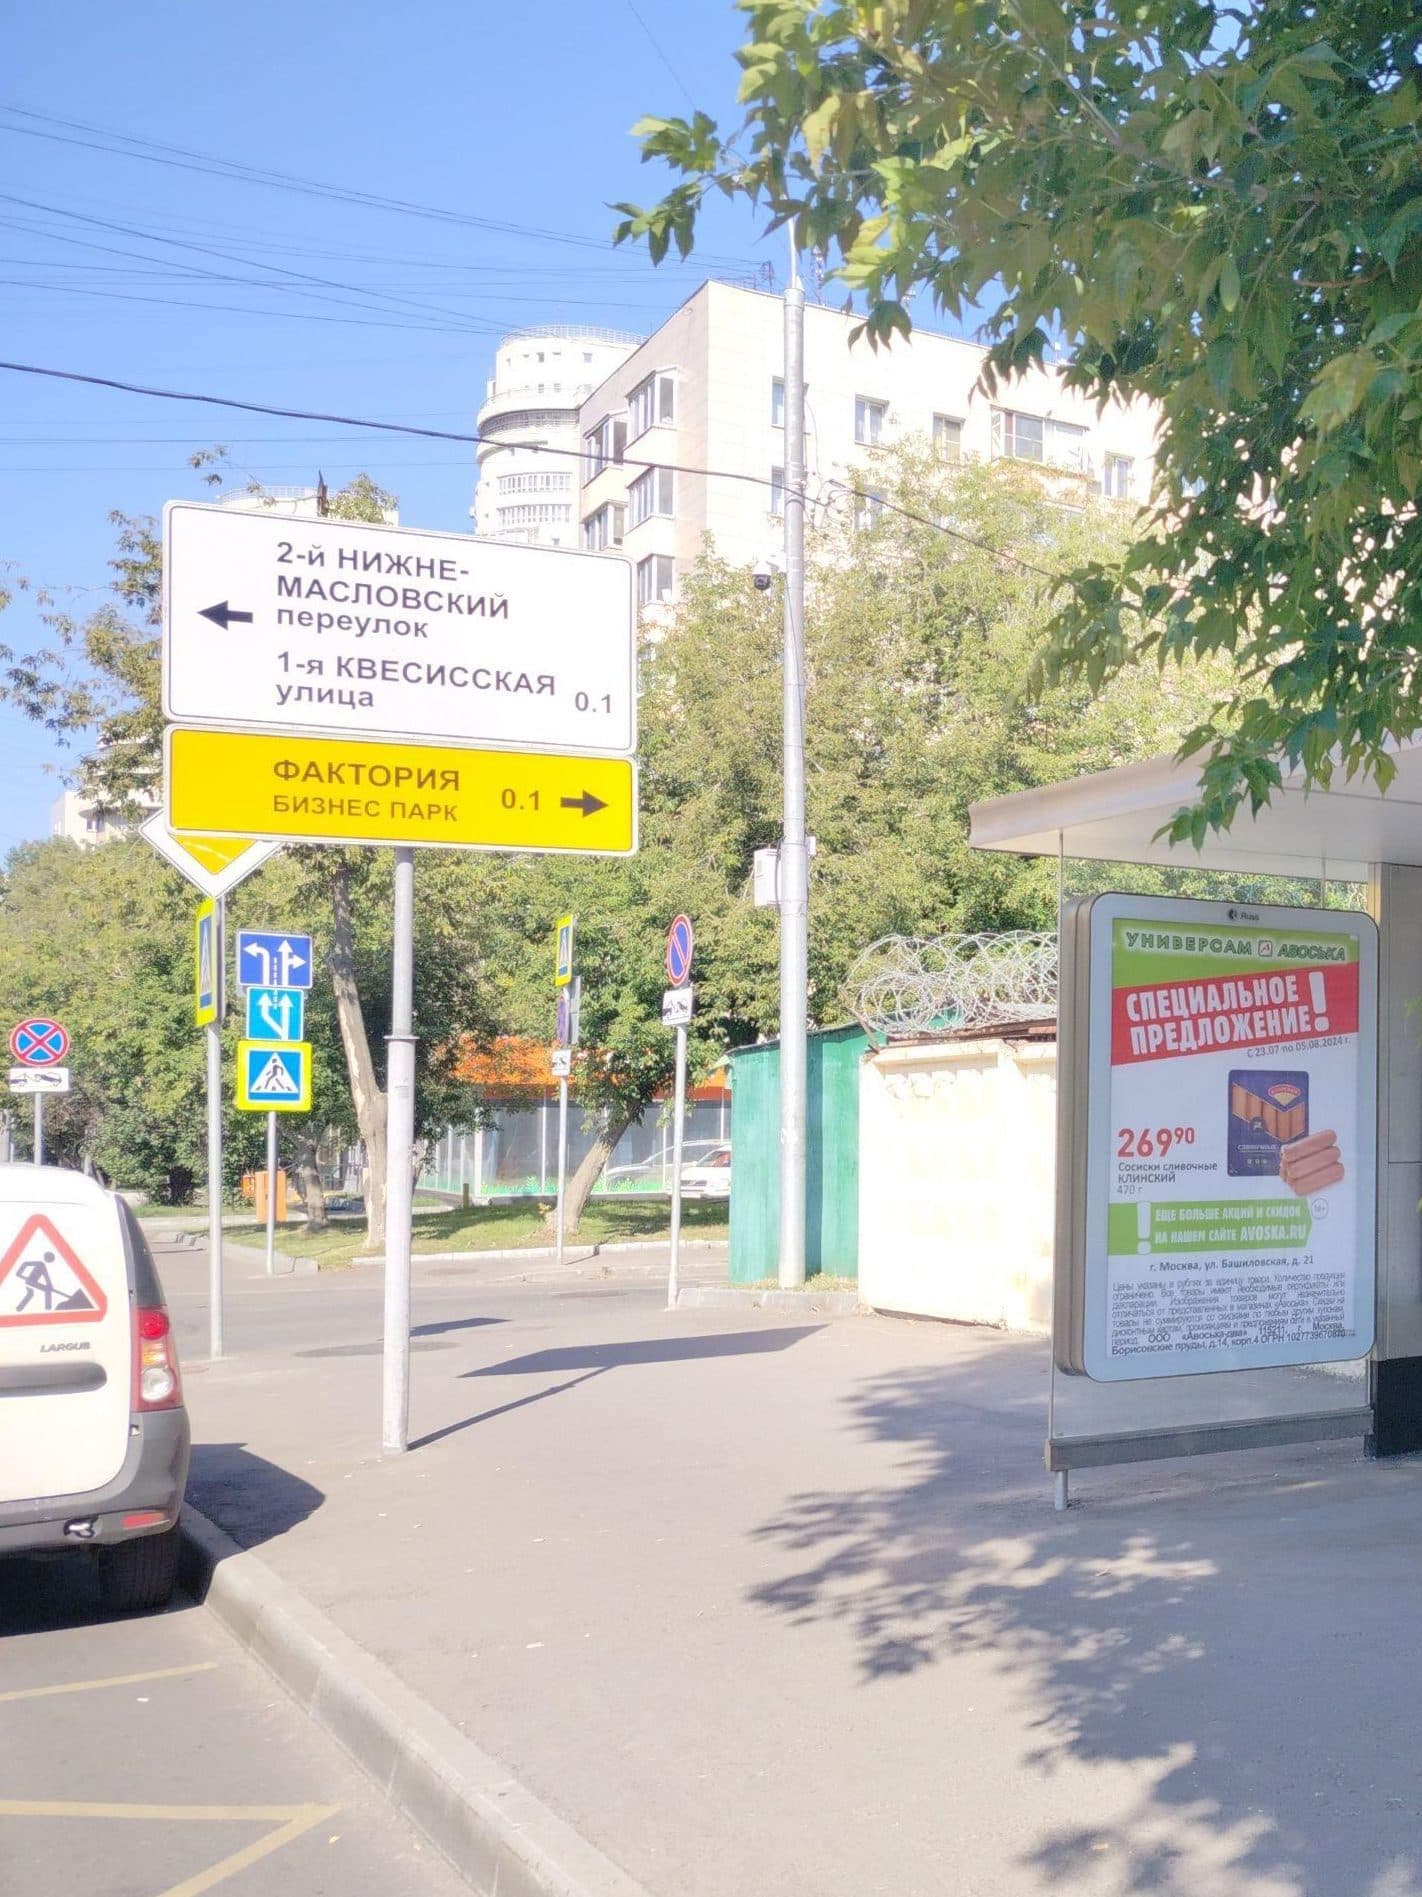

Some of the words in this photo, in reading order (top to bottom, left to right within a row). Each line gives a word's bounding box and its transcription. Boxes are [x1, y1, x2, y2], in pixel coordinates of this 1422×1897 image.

[276, 541, 325, 569] 2-й
[338, 547, 469, 582] НИЖНЕ-
[277, 576, 509, 620] МАСЛОВСКИЙ
[277, 607, 428, 639] переулок
[277, 651, 324, 677] 1-я
[336, 655, 556, 697] КВЕСИССКАЯ
[276, 682, 375, 708] улица
[574, 691, 613, 715] 0.1
[273, 759, 461, 793] ФАКТОРИЯ
[273, 795, 381, 819] БИЗНЕС
[390, 800, 458, 823] ПАРК
[500, 787, 542, 812] 0.1
[1126, 932, 1252, 956] УНИВЕРСАМ
[1277, 943, 1346, 961] АВОСЬКА
[1126, 975, 1300, 1022] СПЕЦИАЛЬНОЕ
[1130, 1005, 1311, 1056] ПРЕДЛОЖЕНИЕ
[1255, 1045, 1280, 1057] 23.07
[1118, 1162, 1160, 1172] Сосиски
[1162, 1162, 1218, 1171] сливочные
[1118, 1171, 1176, 1183] КЛИНСКИЙ
[1117, 1185, 1136, 1195] 470
[1179, 1208, 1220, 1220] БОЛЬШЕ
[1266, 1205, 1301, 1218] СКИДОК
[1155, 1231, 1168, 1244] НА
[1170, 1230, 1206, 1243] НАШЕМ
[1209, 1228, 1237, 1241] САЙТЕ
[1240, 1223, 1307, 1241] AVOSKA.RU
[1159, 1262, 1202, 1272] Москва,
[1302, 1255, 1314, 1265] 21
[39, 1341, 91, 1353] LARGUS
[1148, 1332, 1171, 1343] ООО
